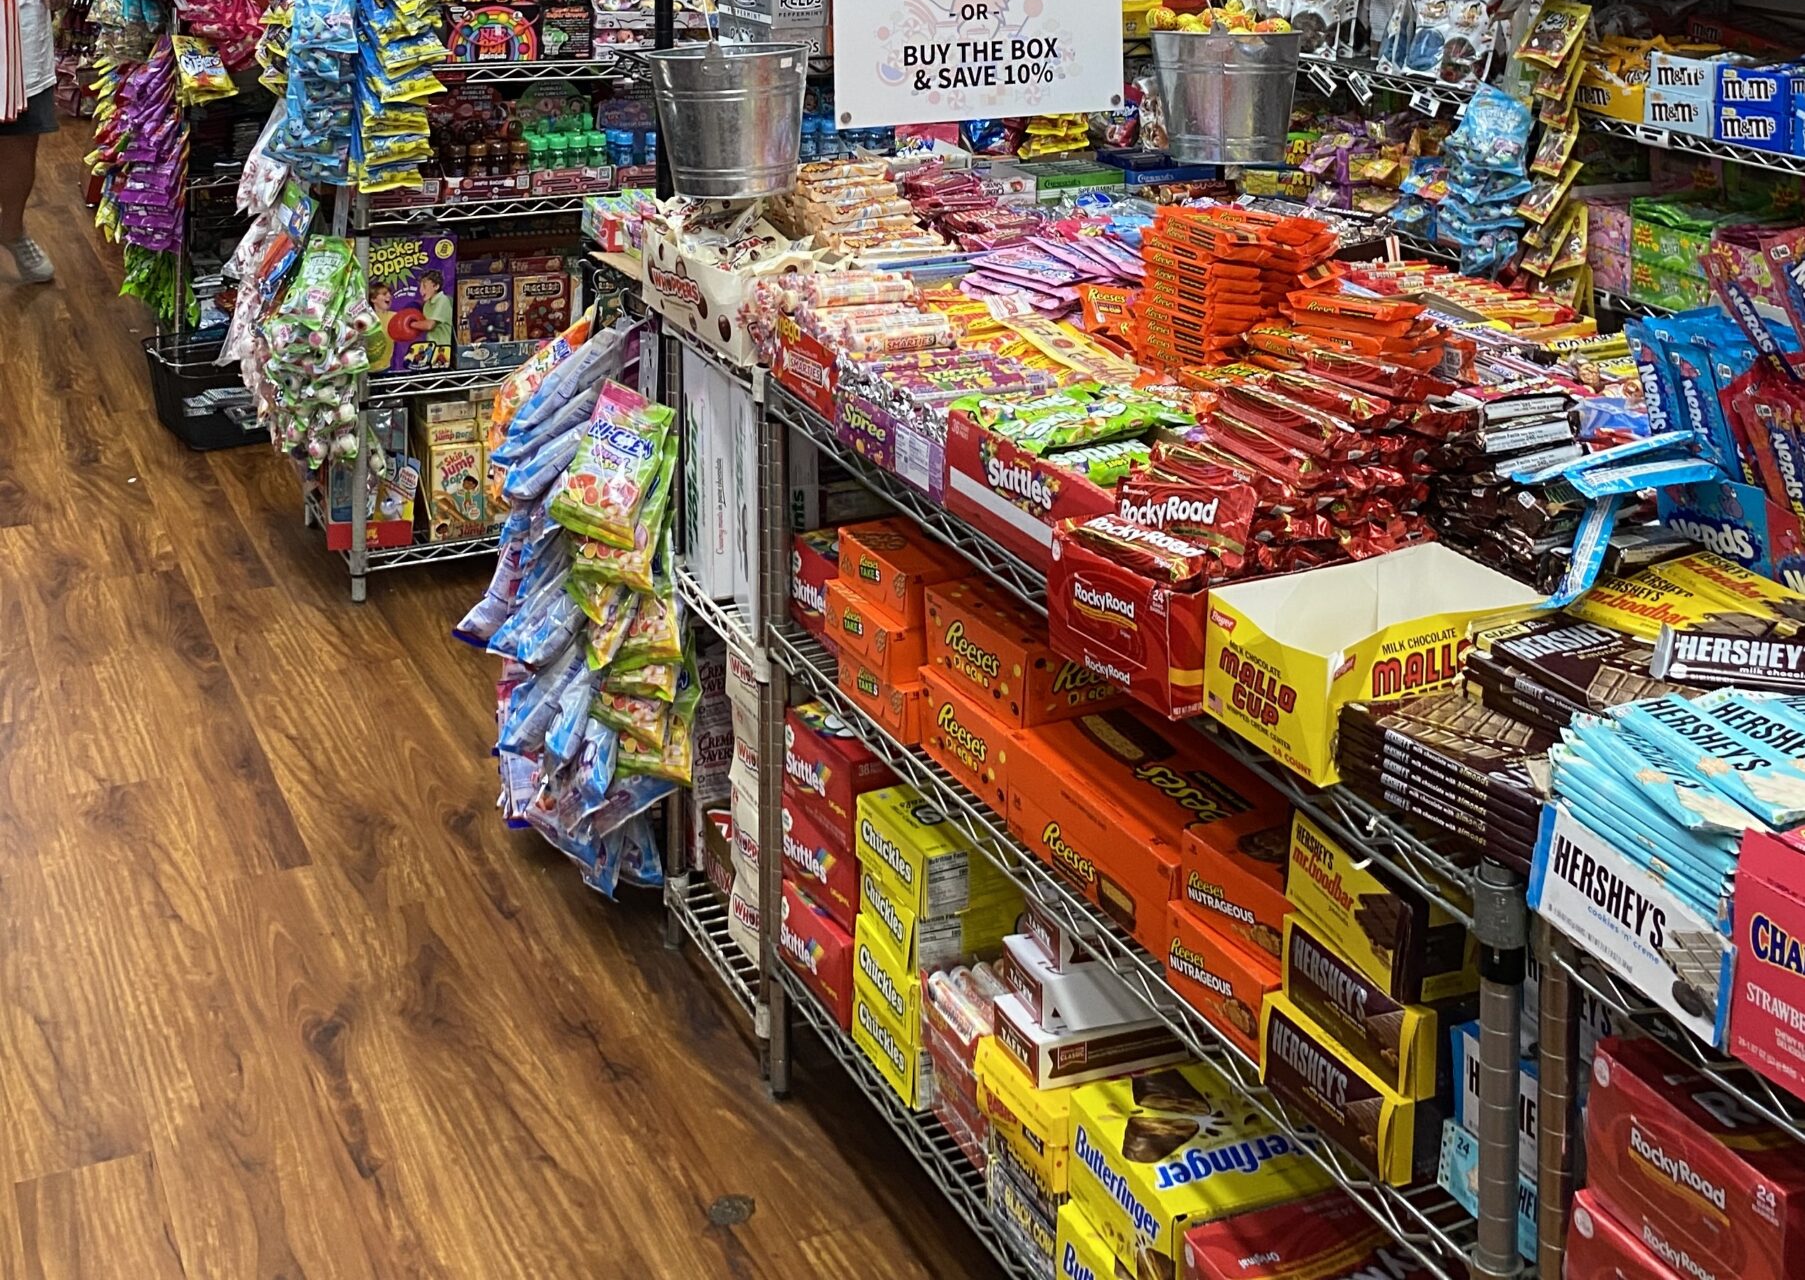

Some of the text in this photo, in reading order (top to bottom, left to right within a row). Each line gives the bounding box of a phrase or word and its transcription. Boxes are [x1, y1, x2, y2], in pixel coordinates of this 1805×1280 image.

[778, 10, 823, 18] PEPPERMINT
[961, 3, 988, 20] OR
[903, 37, 1059, 67] BUY THE BOX
[913, 62, 1054, 91] & SAVE 10%
[1078, 184, 1115, 195] SPEARMINT
[652, 267, 700, 304] WHOPPERS
[886, 334, 936, 350] SMARTIES
[789, 355, 823, 385] SMARTIES
[842, 403, 887, 443] Spree
[440, 455, 476, 481] Jump
[987, 455, 1053, 513] Skittles
[859, 565, 881, 582] TAKE 5
[1152, 588, 1164, 604] 24
[1210, 608, 1236, 630] Boyer
[1381, 627, 1458, 656] MILK CHOCOLATE
[944, 619, 1000, 678] Reese's
[1245, 651, 1283, 680] CHOCOLATE
[1675, 633, 1805, 671] HERSHEY'
[1219, 645, 1298, 714] MALLO
[1231, 682, 1280, 728] CUP
[938, 701, 988, 761] Reese's
[1639, 698, 1772, 772] HERSHEY'S
[785, 750, 826, 797] Skittles
[1458, 764, 1490, 788] almonds
[782, 833, 827, 885] Skittles
[862, 819, 913, 885] Chuckles
[1042, 821, 1097, 884] Reese's
[1295, 823, 1335, 870] HERSHEY'S
[864, 874, 905, 941] Chuckles
[1187, 886, 1255, 925] NUTRAGEOUS
[1553, 834, 1667, 951] HERSHEY'S
[780, 926, 818, 976] Skittles
[1587, 902, 1660, 966] cookies creme
[859, 944, 905, 1017] Chuckles
[1009, 969, 1033, 1002] TAFFY
[1169, 953, 1233, 997] NUTRAGEOUS
[1292, 932, 1368, 1020] HERSHEY'S
[1746, 981, 1805, 1034] STRAWBE
[858, 1001, 906, 1072] Chuckles
[1001, 1027, 1029, 1062] TAFFY
[1272, 1017, 1348, 1107] HERSHEY'S
[1075, 1123, 1161, 1242] Butterfinger
[1004, 1186, 1055, 1259] BLACK COW
